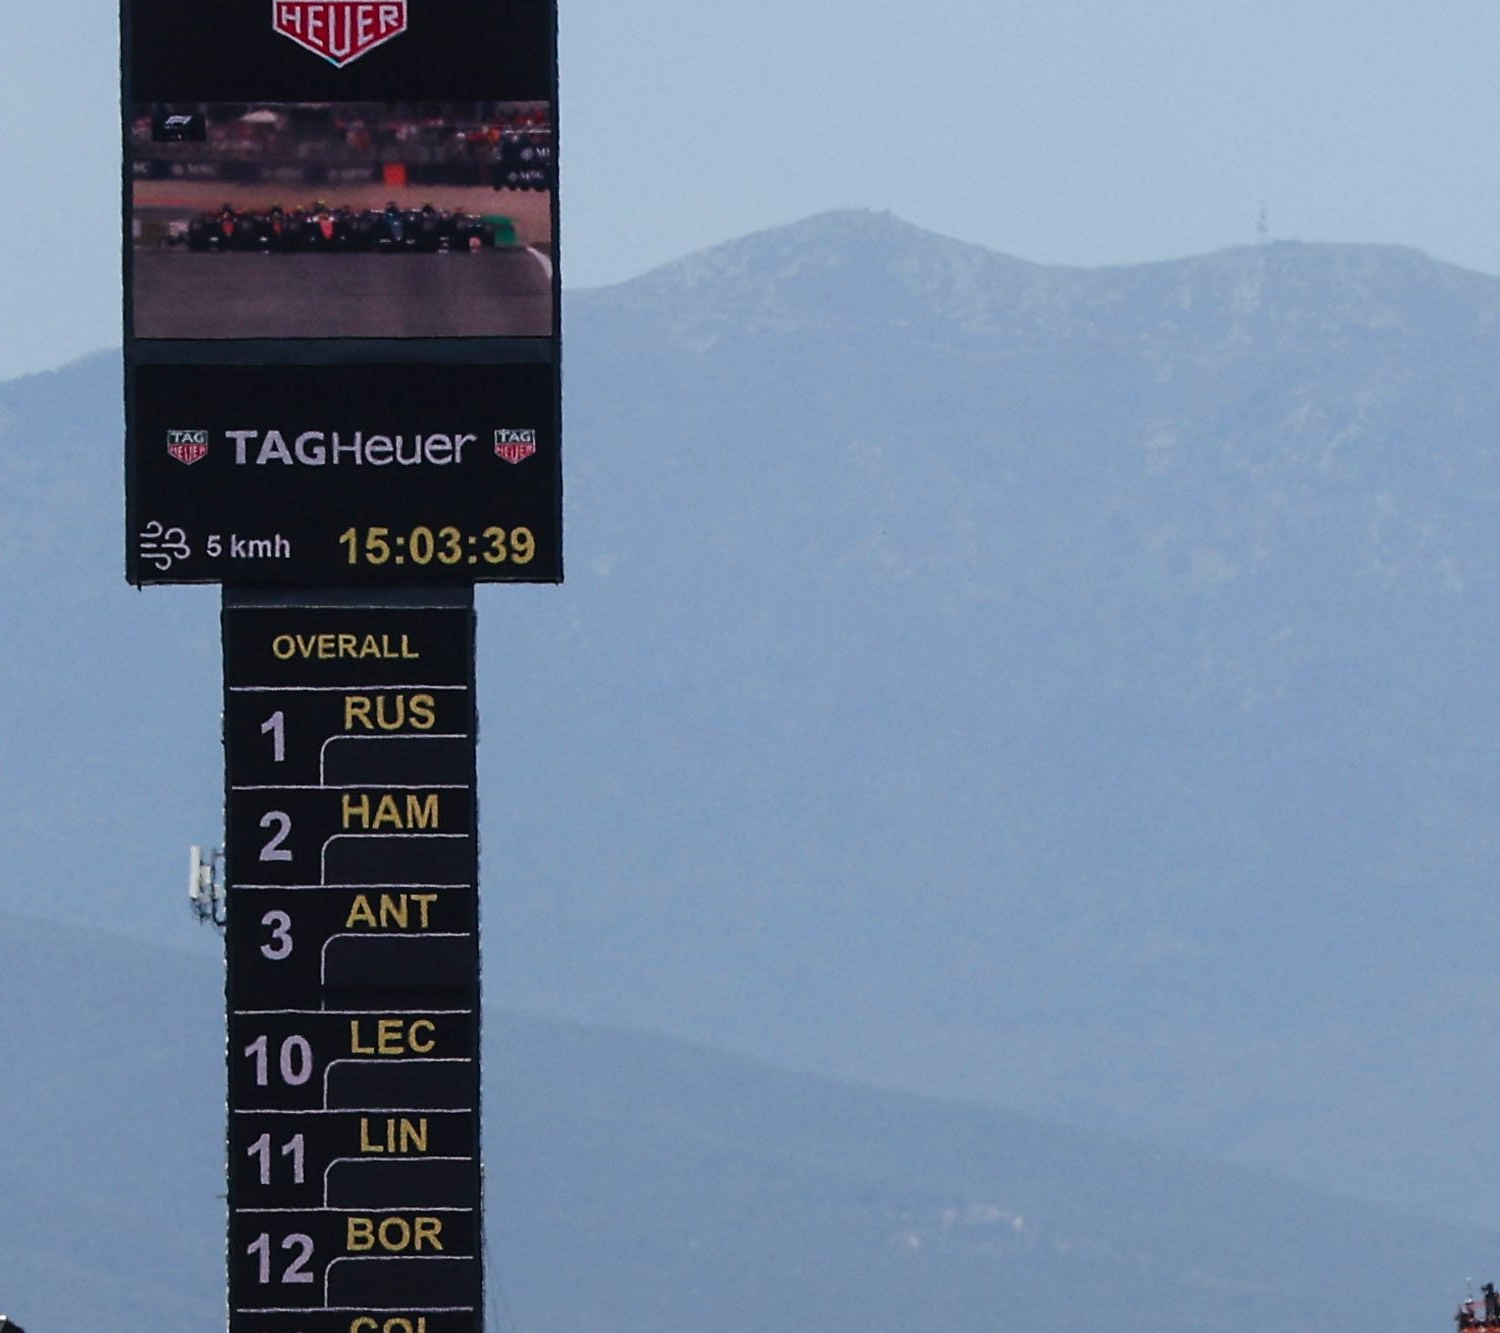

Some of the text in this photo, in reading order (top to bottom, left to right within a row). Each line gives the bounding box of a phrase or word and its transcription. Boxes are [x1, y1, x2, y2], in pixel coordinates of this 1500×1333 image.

[281, 4, 400, 57] HEUER
[171, 431, 205, 444] TAG
[225, 430, 477, 466] TAGHeuer
[496, 430, 532, 442] TAG
[206, 534, 291, 558] 5 kmh
[339, 526, 536, 565] 15:03:39
[272, 634, 420, 659] OVERALL
[260, 695, 436, 762] 1 RUS
[259, 794, 439, 861] 2 HAM
[259, 894, 438, 960] 3 ANT
[243, 1019, 436, 1086] 10 LEC
[246, 1118, 428, 1185] 11 LIN
[246, 1216, 444, 1284] 12 BOR
